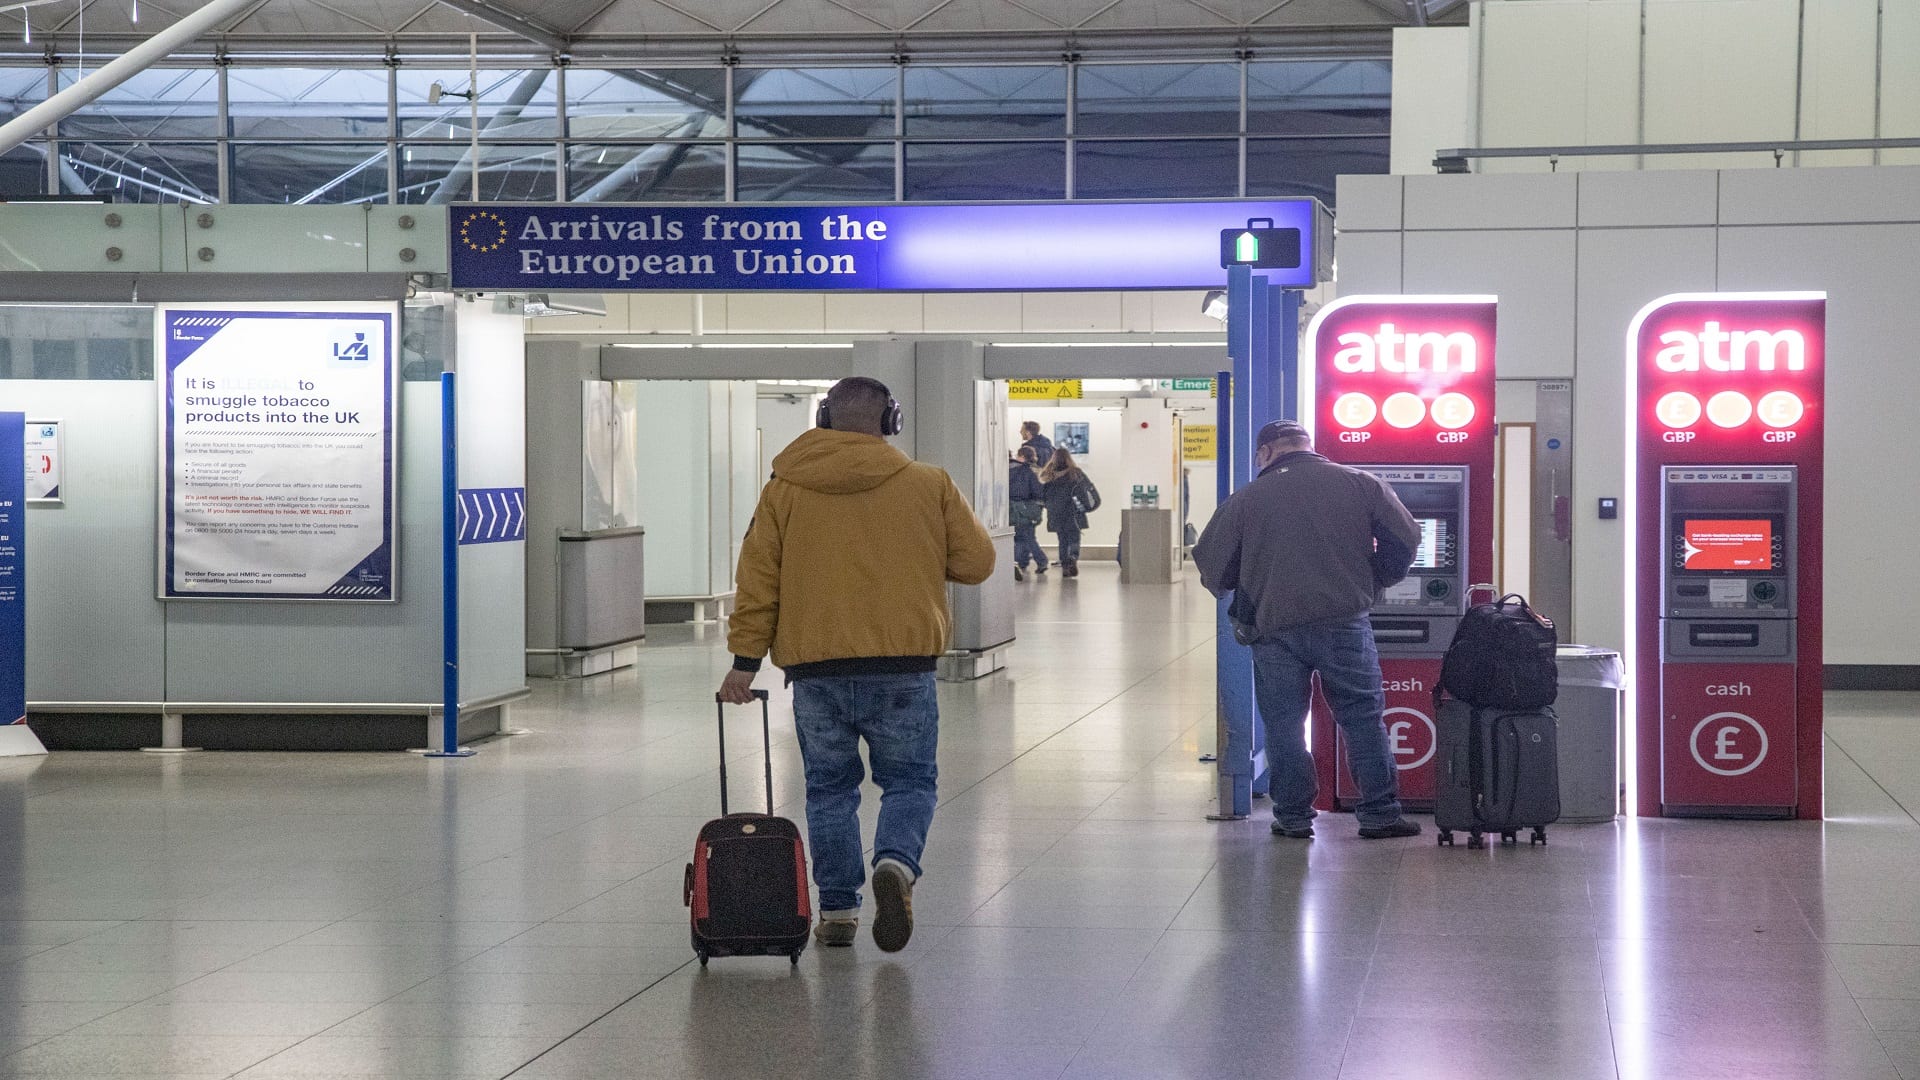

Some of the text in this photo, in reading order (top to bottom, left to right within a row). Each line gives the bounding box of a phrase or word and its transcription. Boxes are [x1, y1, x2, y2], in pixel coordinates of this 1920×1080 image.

[518, 215, 887, 240] Arrivals from the
[519, 248, 856, 281] European Union
[1334, 324, 1476, 374] atm
[1656, 321, 1804, 372] atm
[186, 378, 196, 389] It
[202, 378, 215, 389] is
[298, 380, 314, 390] to
[186, 394, 330, 408] smuggle tobacco
[186, 411, 360, 424] products into the UK
[1339, 432, 1469, 443] GBP GBP
[1663, 431, 1796, 442] GBP GBP
[1381, 678, 1422, 691] cash
[1705, 682, 1751, 696] cash
[1388, 721, 1415, 754] £
[1714, 726, 1744, 760] £
